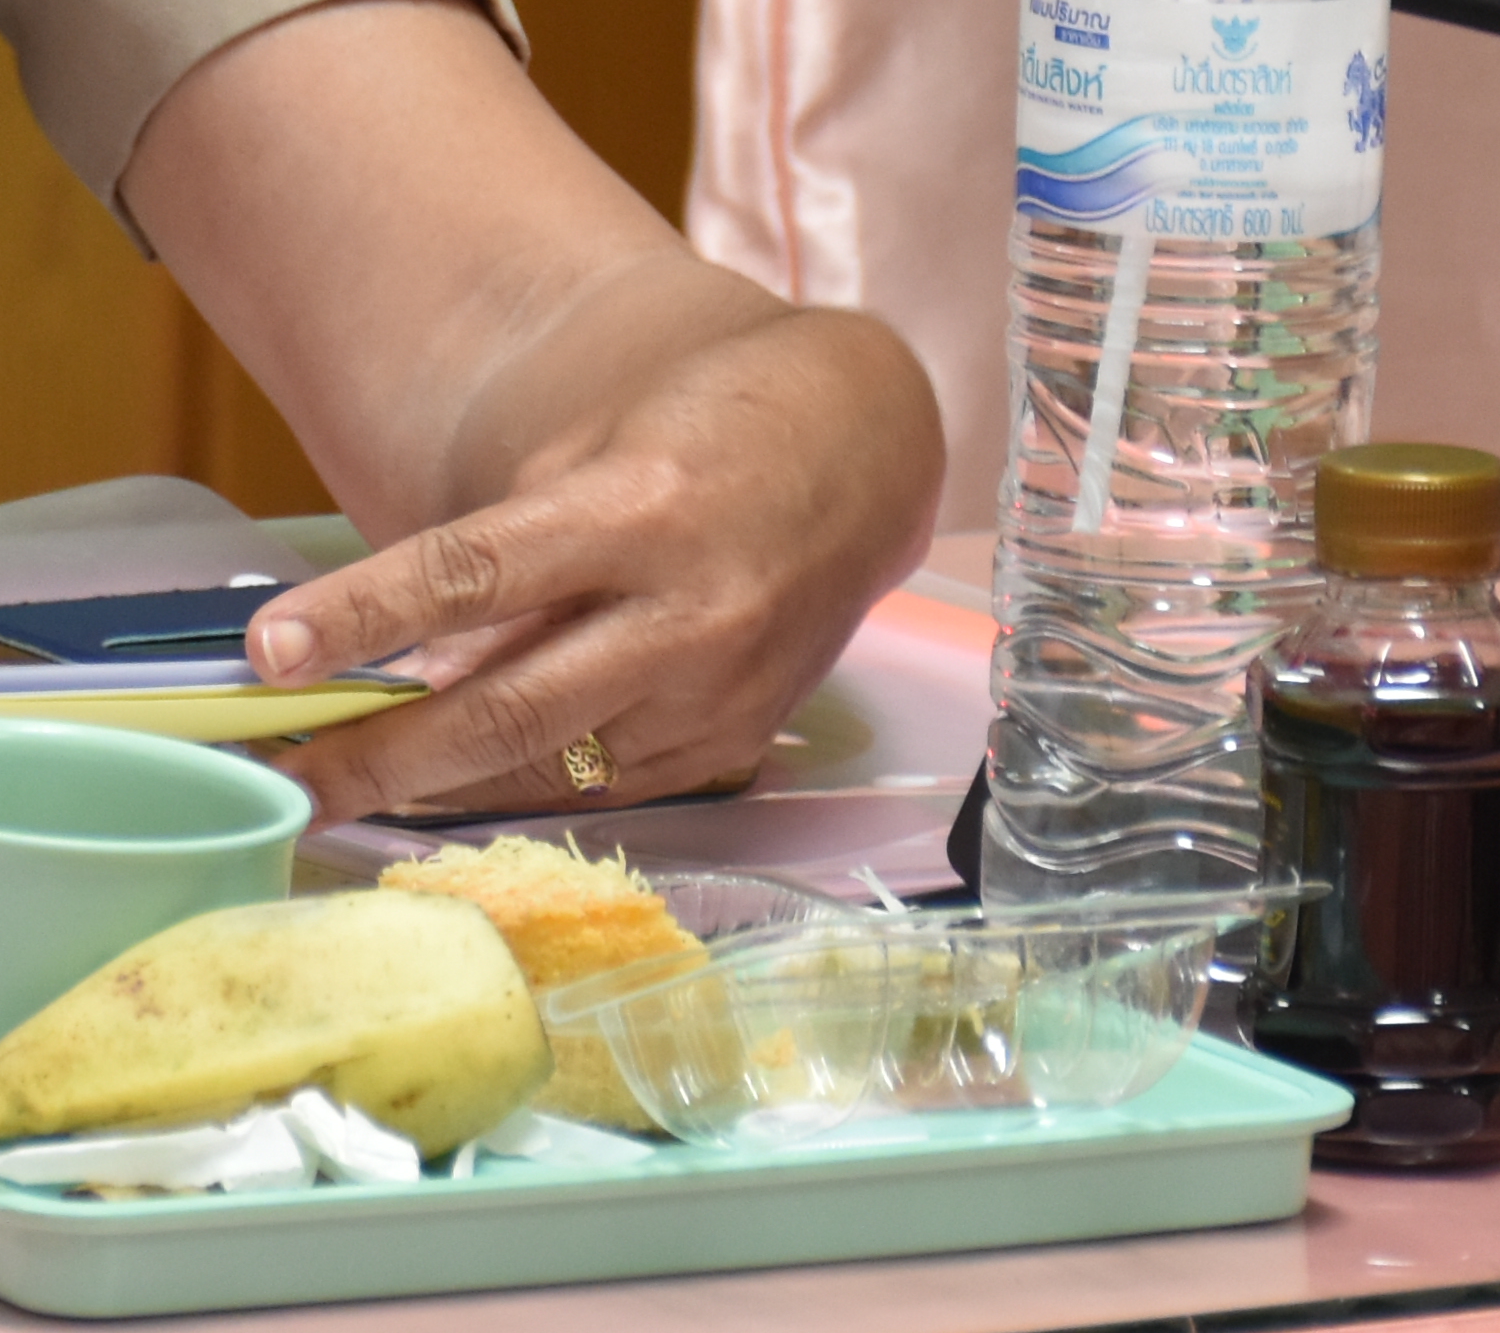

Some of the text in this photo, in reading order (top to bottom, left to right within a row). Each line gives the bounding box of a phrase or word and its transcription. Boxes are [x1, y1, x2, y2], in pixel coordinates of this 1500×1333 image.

[1173, 53, 1293, 95] น้ำดื่มตราสิงห์
[1067, 100, 1104, 115] WATER
[1146, 198, 1233, 241] ปริมาตรสุทธิ
[1243, 208, 1272, 237] 600
